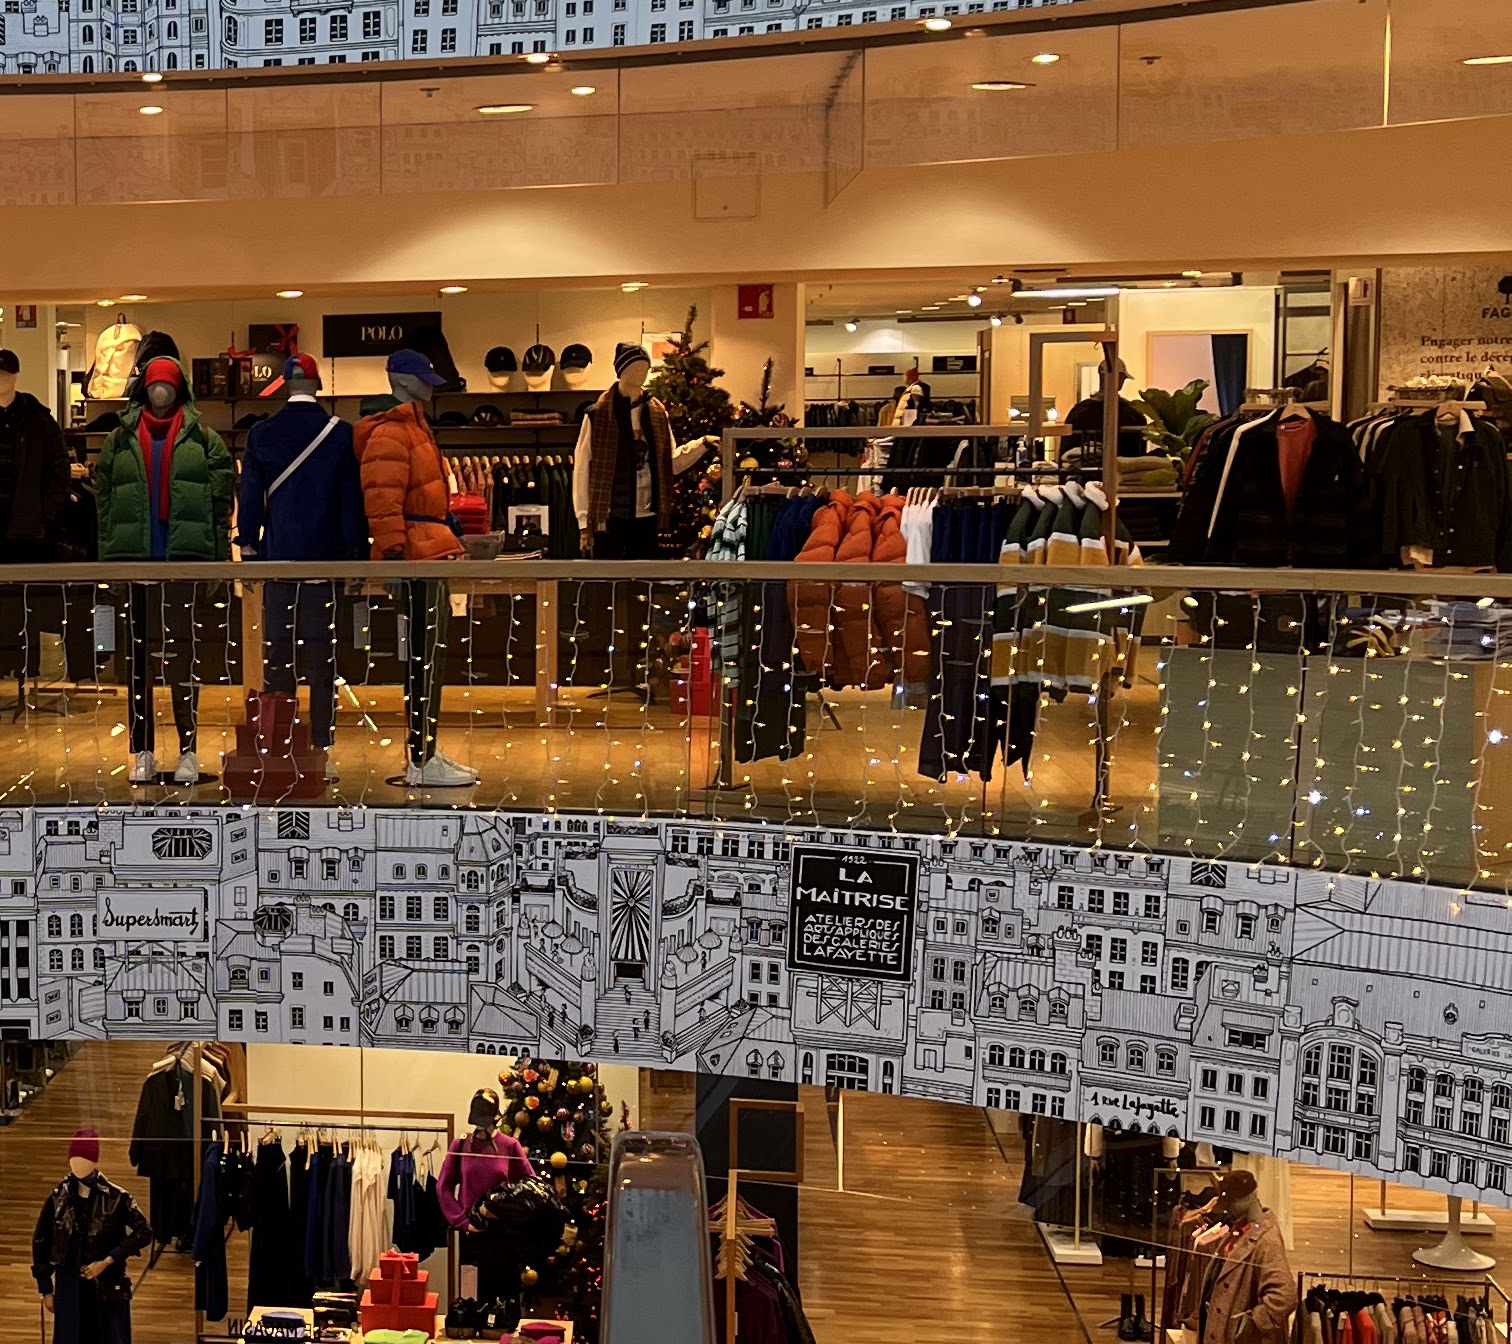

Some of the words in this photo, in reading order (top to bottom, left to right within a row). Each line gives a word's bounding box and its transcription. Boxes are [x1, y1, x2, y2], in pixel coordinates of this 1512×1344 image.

[1481, 307, 1512, 319] FAG
[360, 324, 404, 342] POLO
[1420, 353, 1463, 364] contre
[1465, 351, 1478, 364] le
[841, 855, 868, 865] 1922
[839, 867, 873, 884] LA
[101, 896, 199, 936] Supersmart
[804, 913, 874, 928] ATELIERS
[875, 919, 901, 931] DES
[803, 923, 837, 934] ARTS
[803, 932, 831, 944] DES
[802, 943, 899, 965] LAFAYETTE
[1091, 1091, 1100, 1106] 1
[1122, 1093, 1179, 1120] Lafayette
